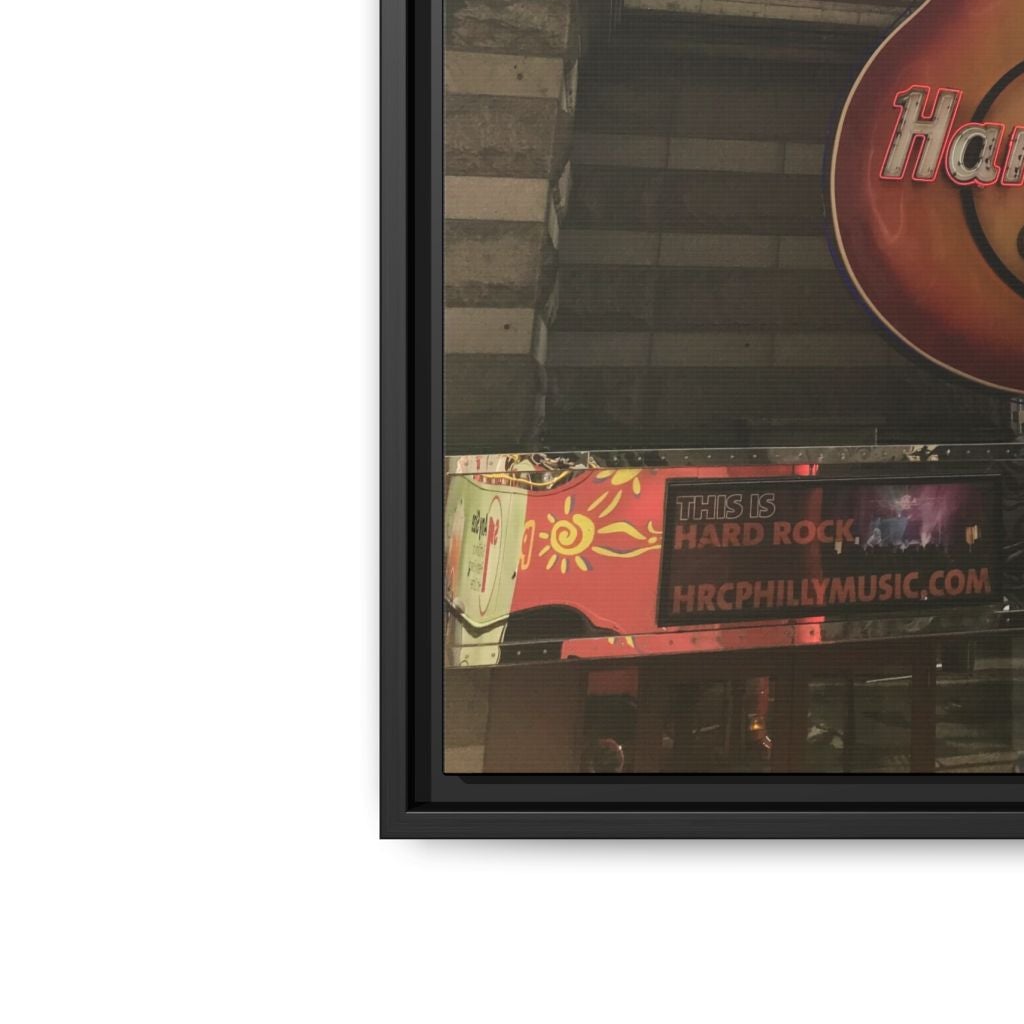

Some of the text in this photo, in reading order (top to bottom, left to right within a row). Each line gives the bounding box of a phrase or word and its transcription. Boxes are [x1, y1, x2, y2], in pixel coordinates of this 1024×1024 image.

[675, 492, 776, 521] THIS IS
[673, 522, 765, 550] HARD
[671, 567, 992, 615] HRCPHILLYMUSIC.COM
